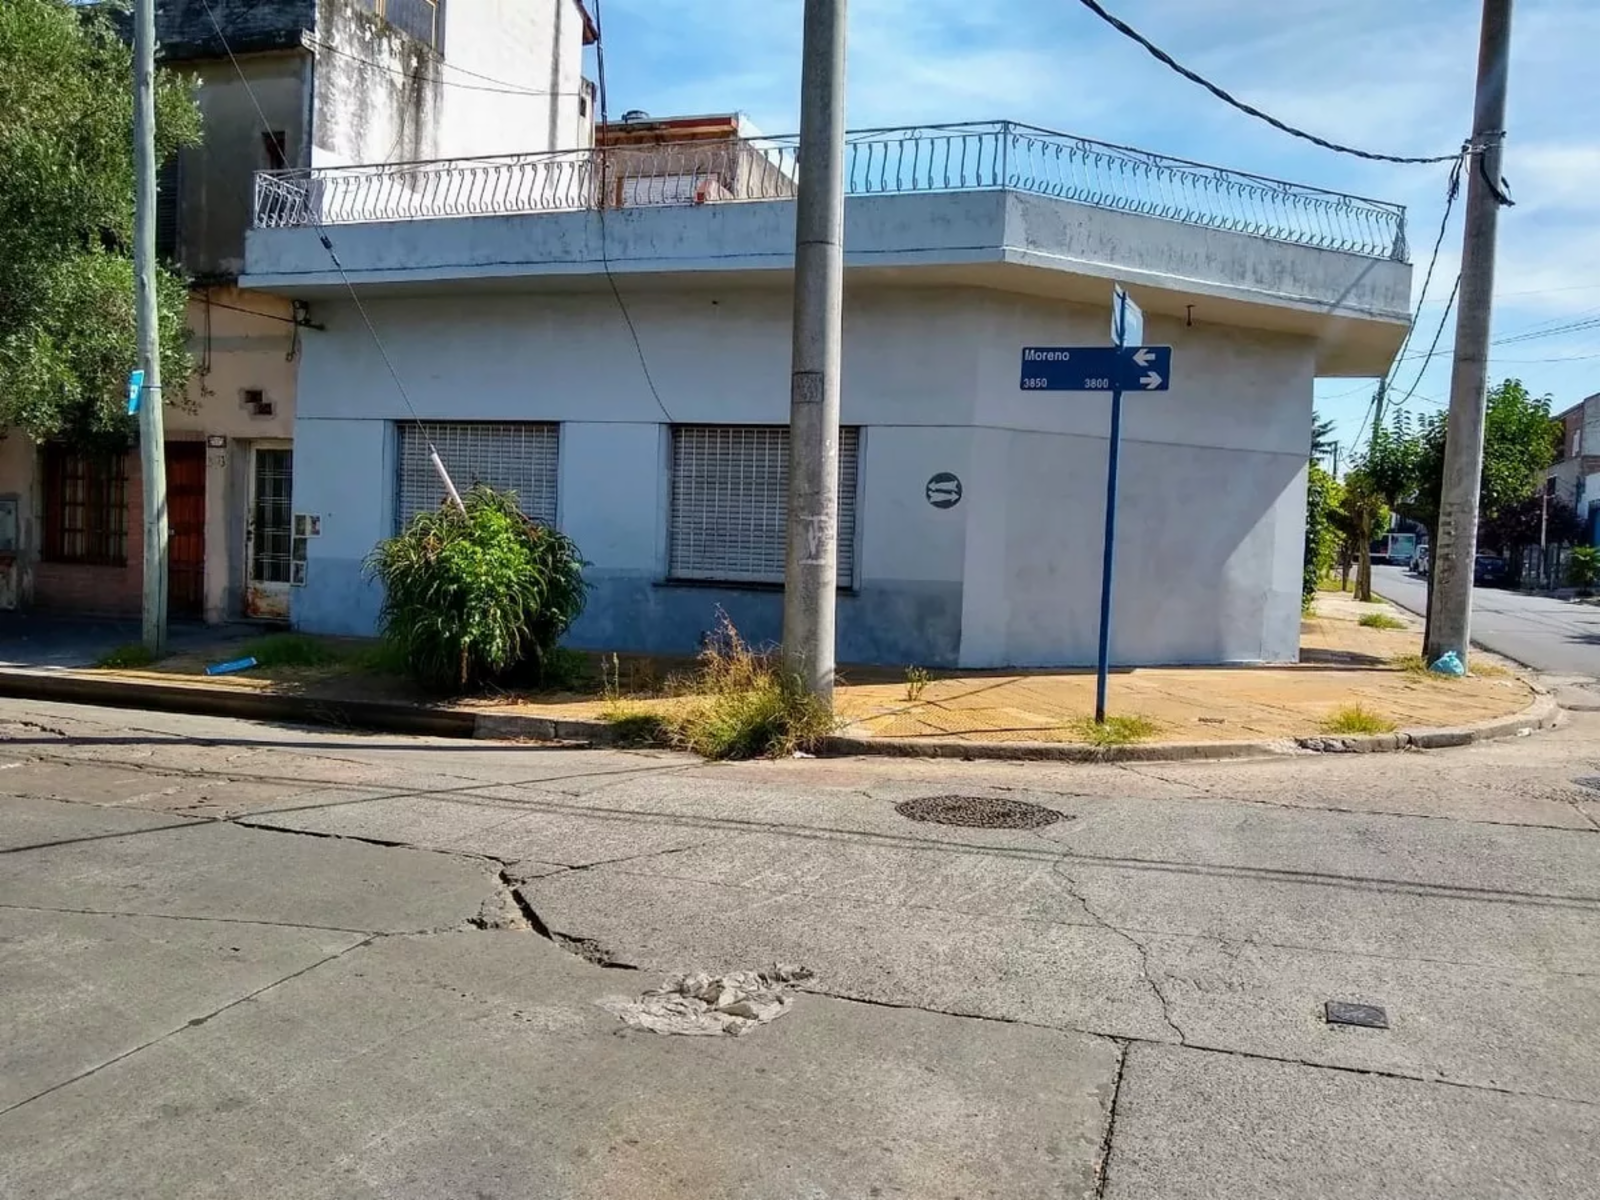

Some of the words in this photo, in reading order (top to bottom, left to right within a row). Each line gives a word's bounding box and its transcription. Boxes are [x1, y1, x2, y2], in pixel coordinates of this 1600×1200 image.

[1024, 349, 1070, 361] Moreno
[1023, 378, 1048, 389] 3850
[1084, 378, 1109, 389] 3800
